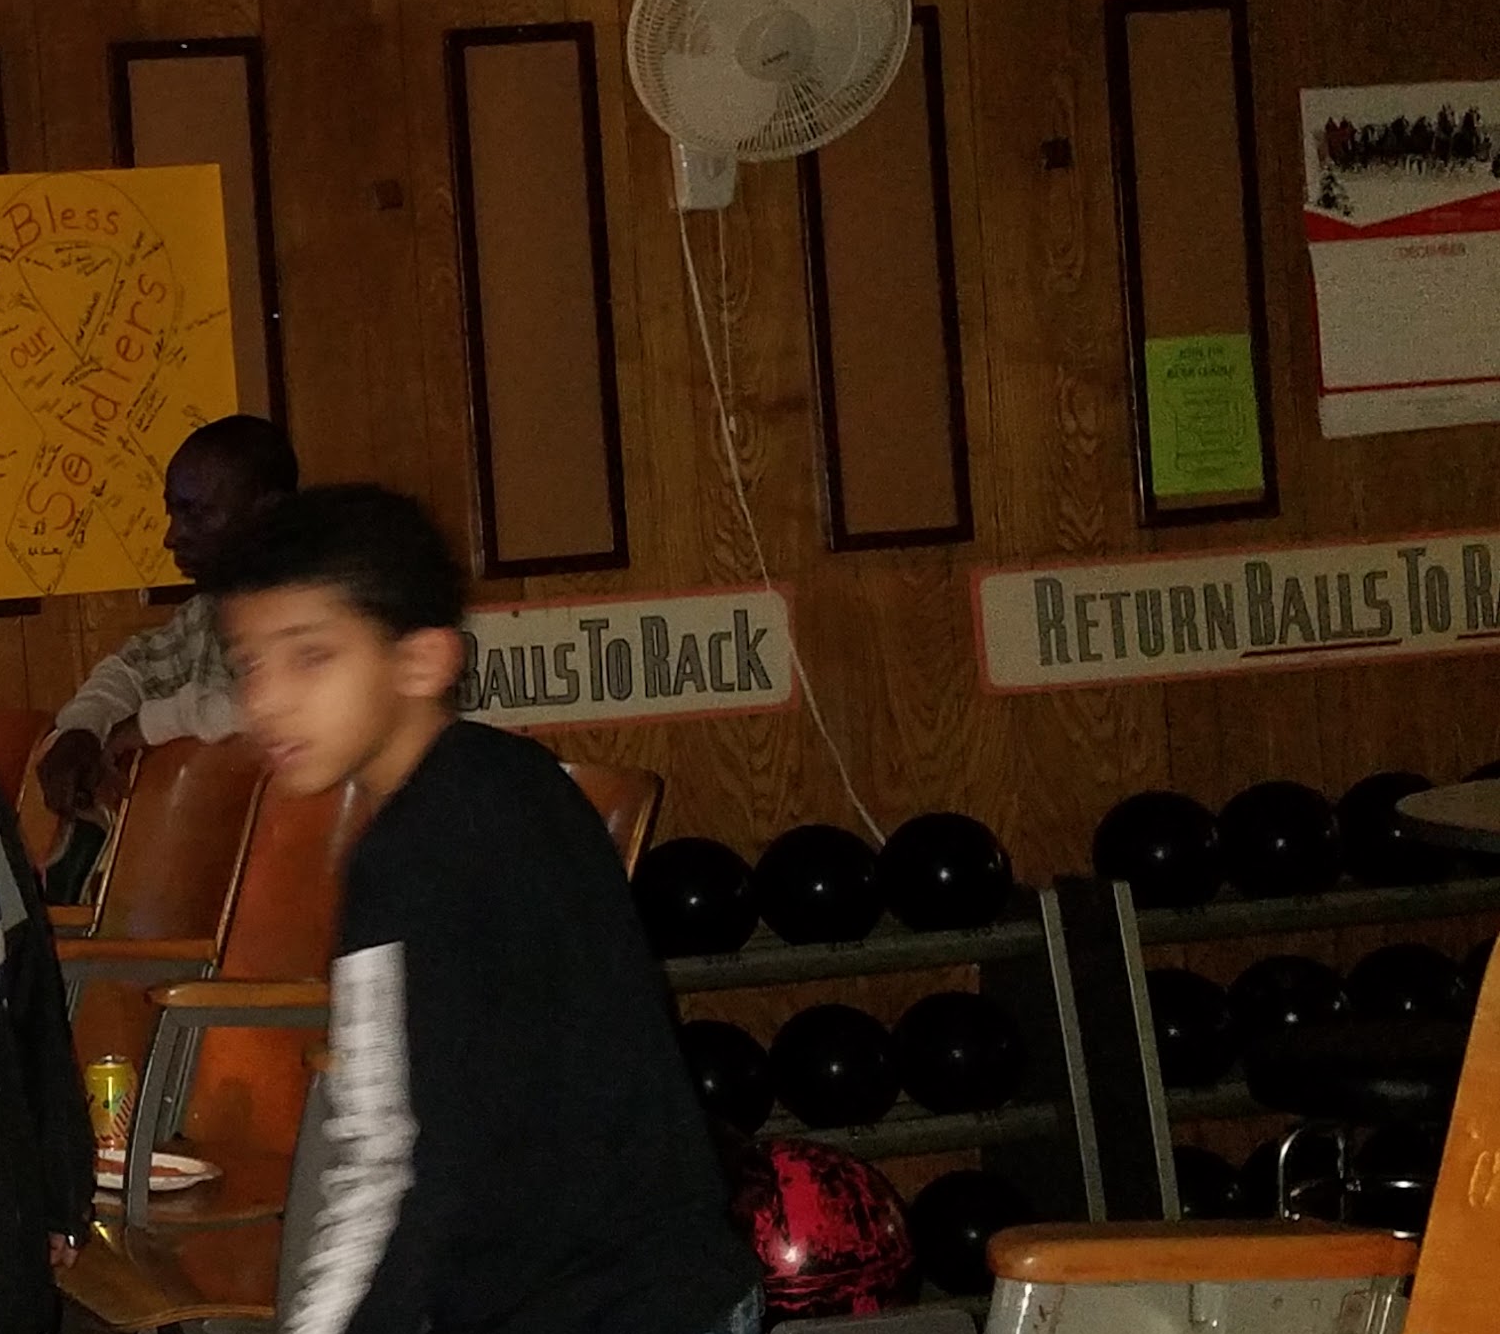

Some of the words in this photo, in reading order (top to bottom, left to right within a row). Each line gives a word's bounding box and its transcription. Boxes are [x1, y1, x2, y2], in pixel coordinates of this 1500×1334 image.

[3, 195, 120, 261] Bless
[1034, 577, 1238, 667] RETURN
[1244, 561, 1393, 646] BALLS
